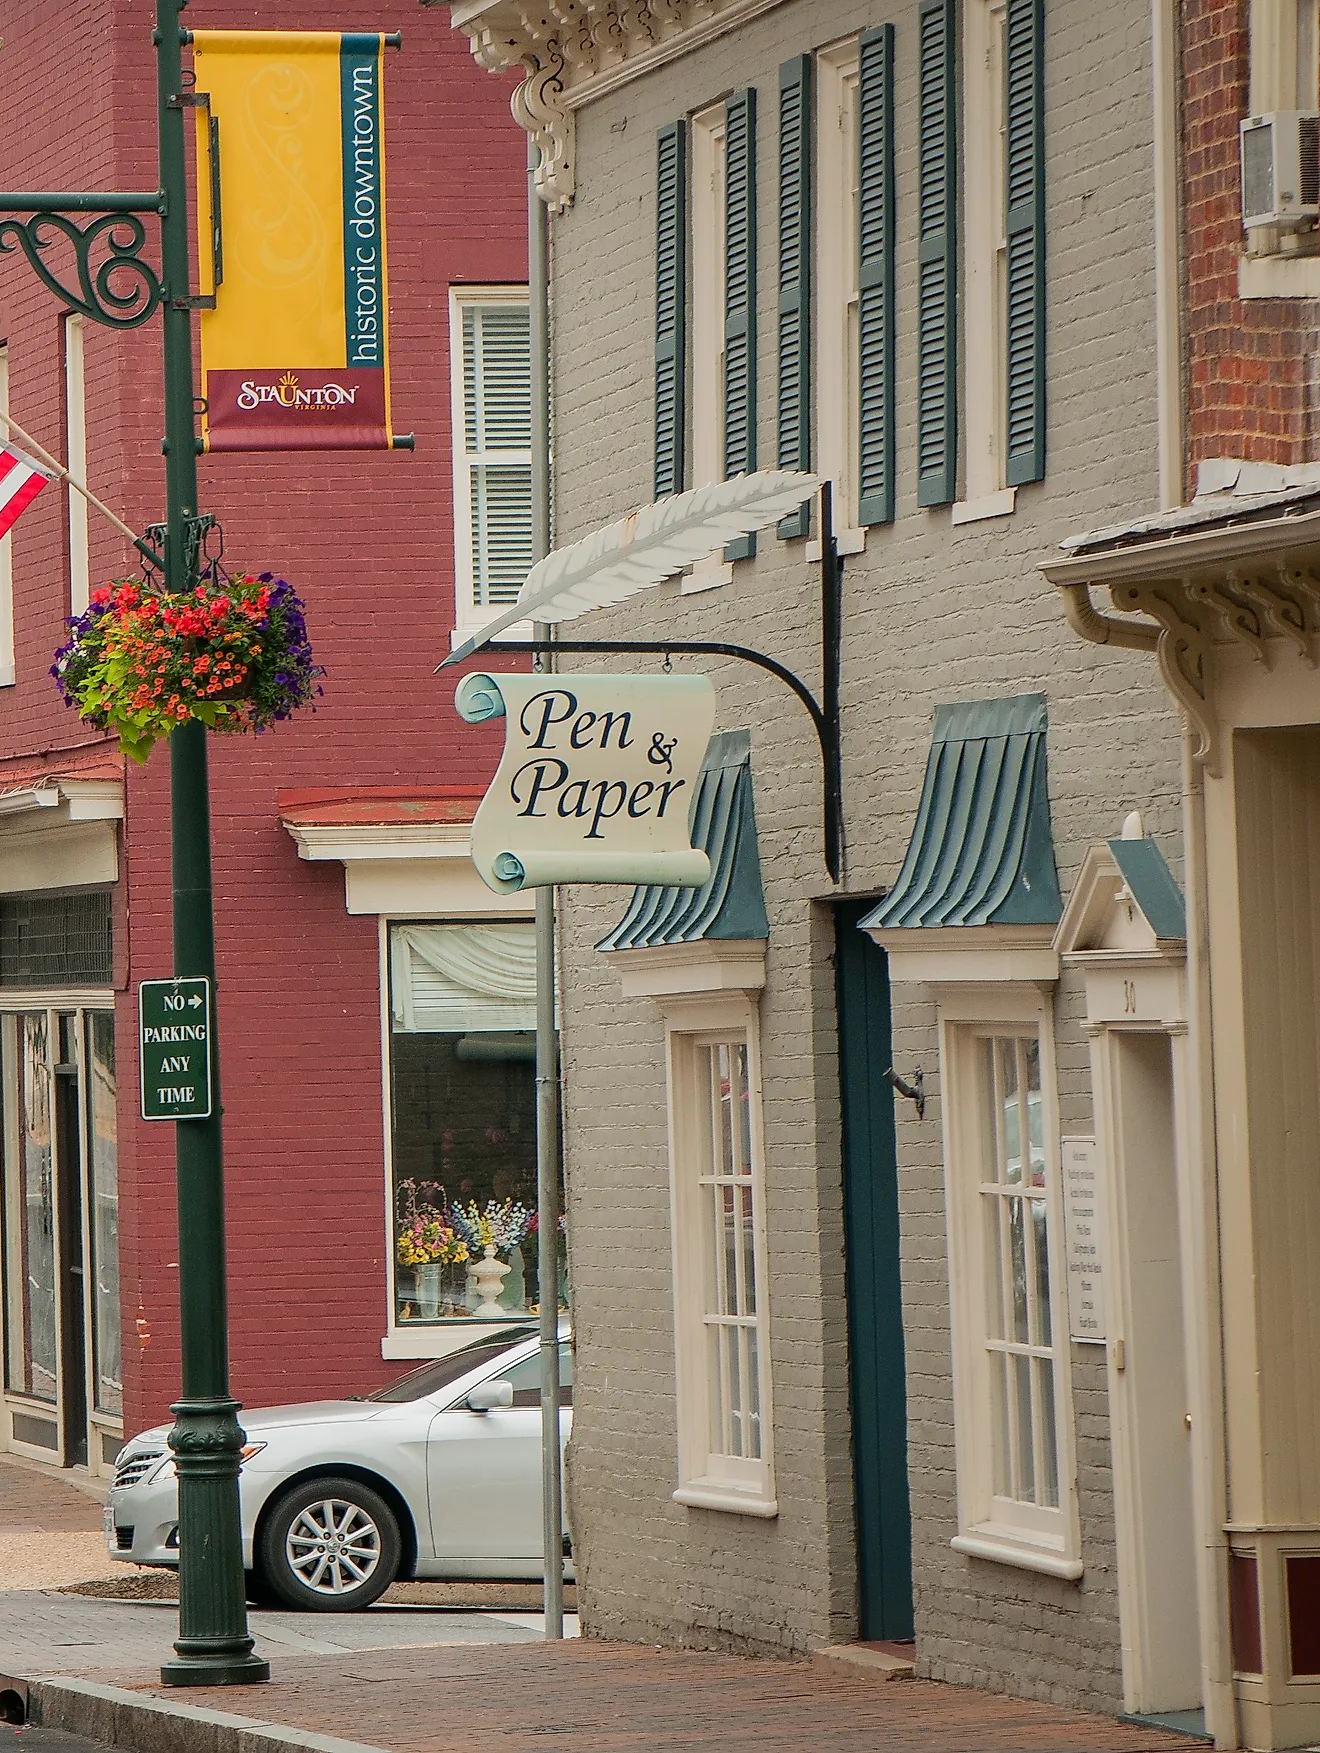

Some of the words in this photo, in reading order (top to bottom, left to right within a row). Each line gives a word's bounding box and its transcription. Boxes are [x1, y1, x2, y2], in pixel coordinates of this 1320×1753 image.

[349, 64, 378, 240] downtown
[350, 245, 379, 363] historic
[237, 380, 357, 410] STAUNTON
[519, 689, 634, 751] Pen
[647, 731, 679, 774] &
[510, 757, 686, 840] Paper
[163, 995, 185, 1012] NO
[1123, 980, 1136, 1014] 30
[143, 1025, 206, 1043] PARKING
[160, 1056, 191, 1073] ANY
[157, 1086, 195, 1104] TIME
